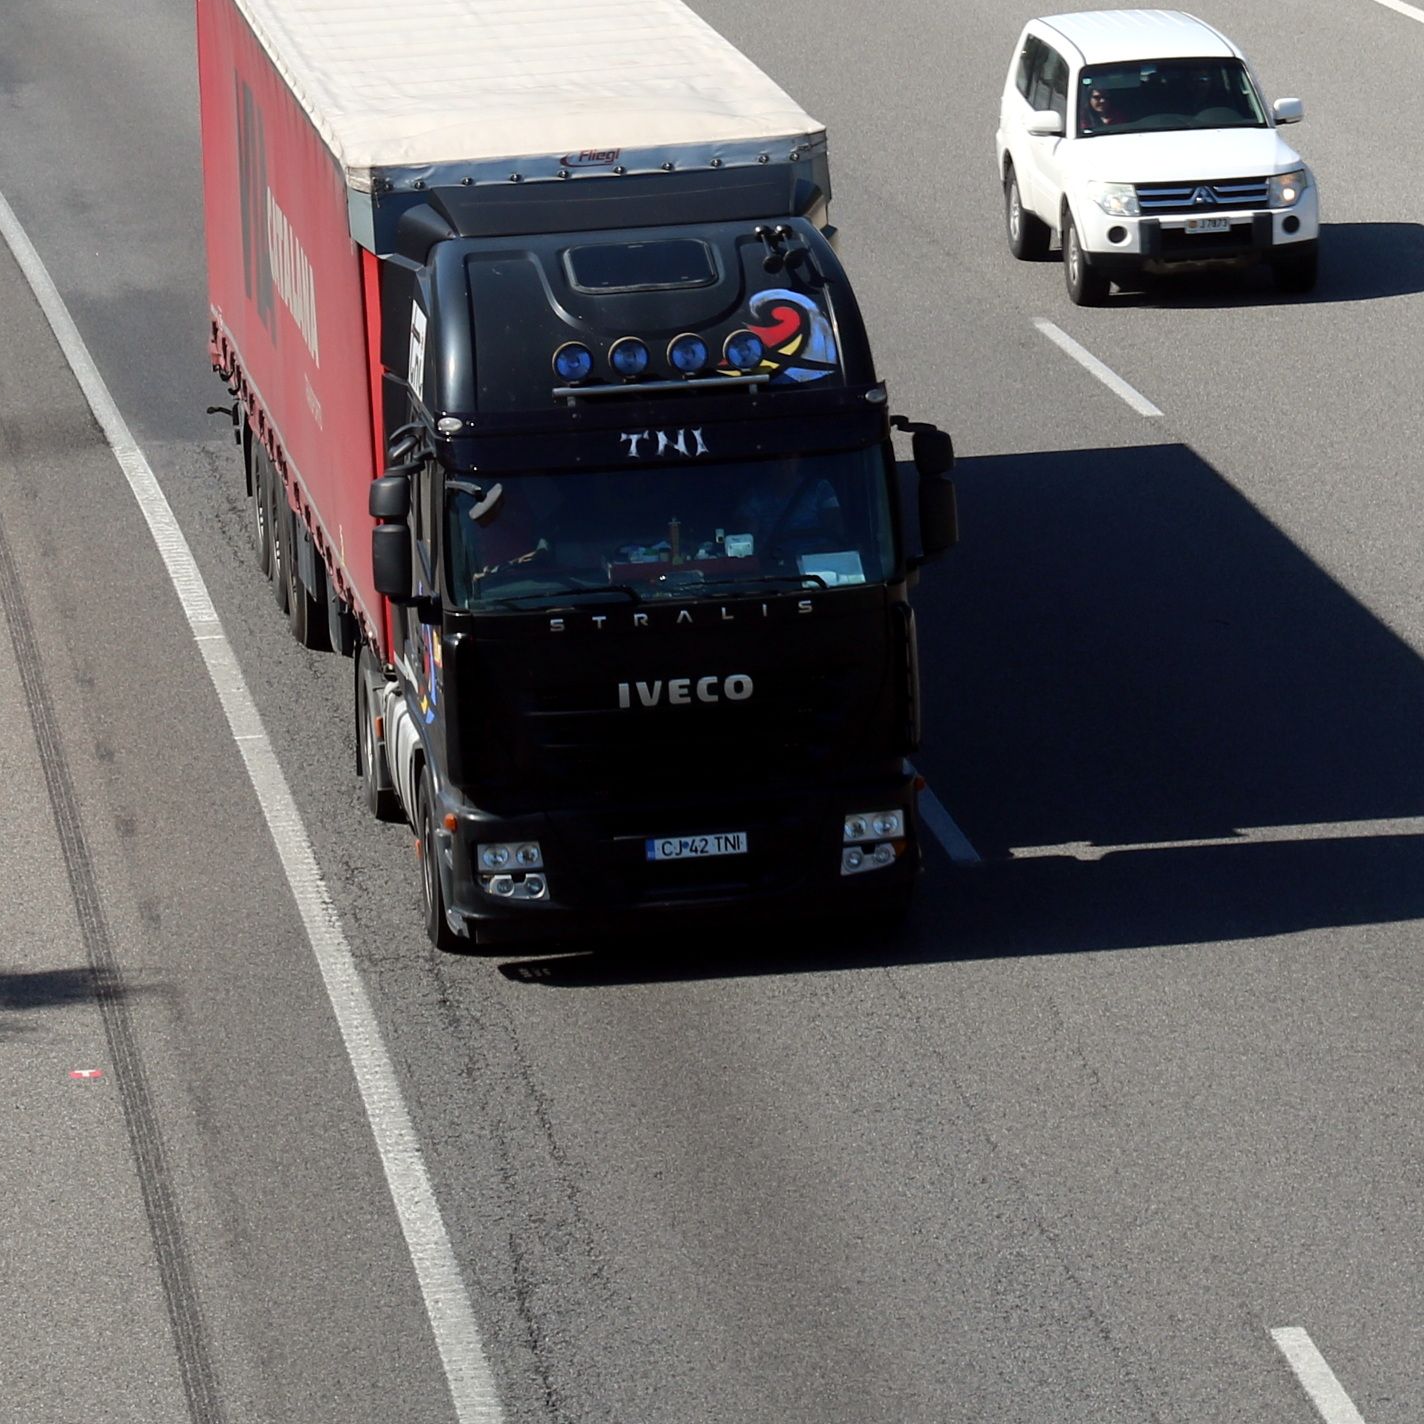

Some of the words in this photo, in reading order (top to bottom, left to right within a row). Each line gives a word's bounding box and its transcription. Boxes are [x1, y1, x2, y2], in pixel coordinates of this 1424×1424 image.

[267, 186, 320, 369] CATALANA
[620, 427, 710, 458] TNI
[550, 600, 813, 632] STRALIS
[618, 674, 754, 708] IVECO
[661, 840, 683, 856] CJ
[689, 838, 709, 854] 42
[714, 835, 740, 852] TNI
